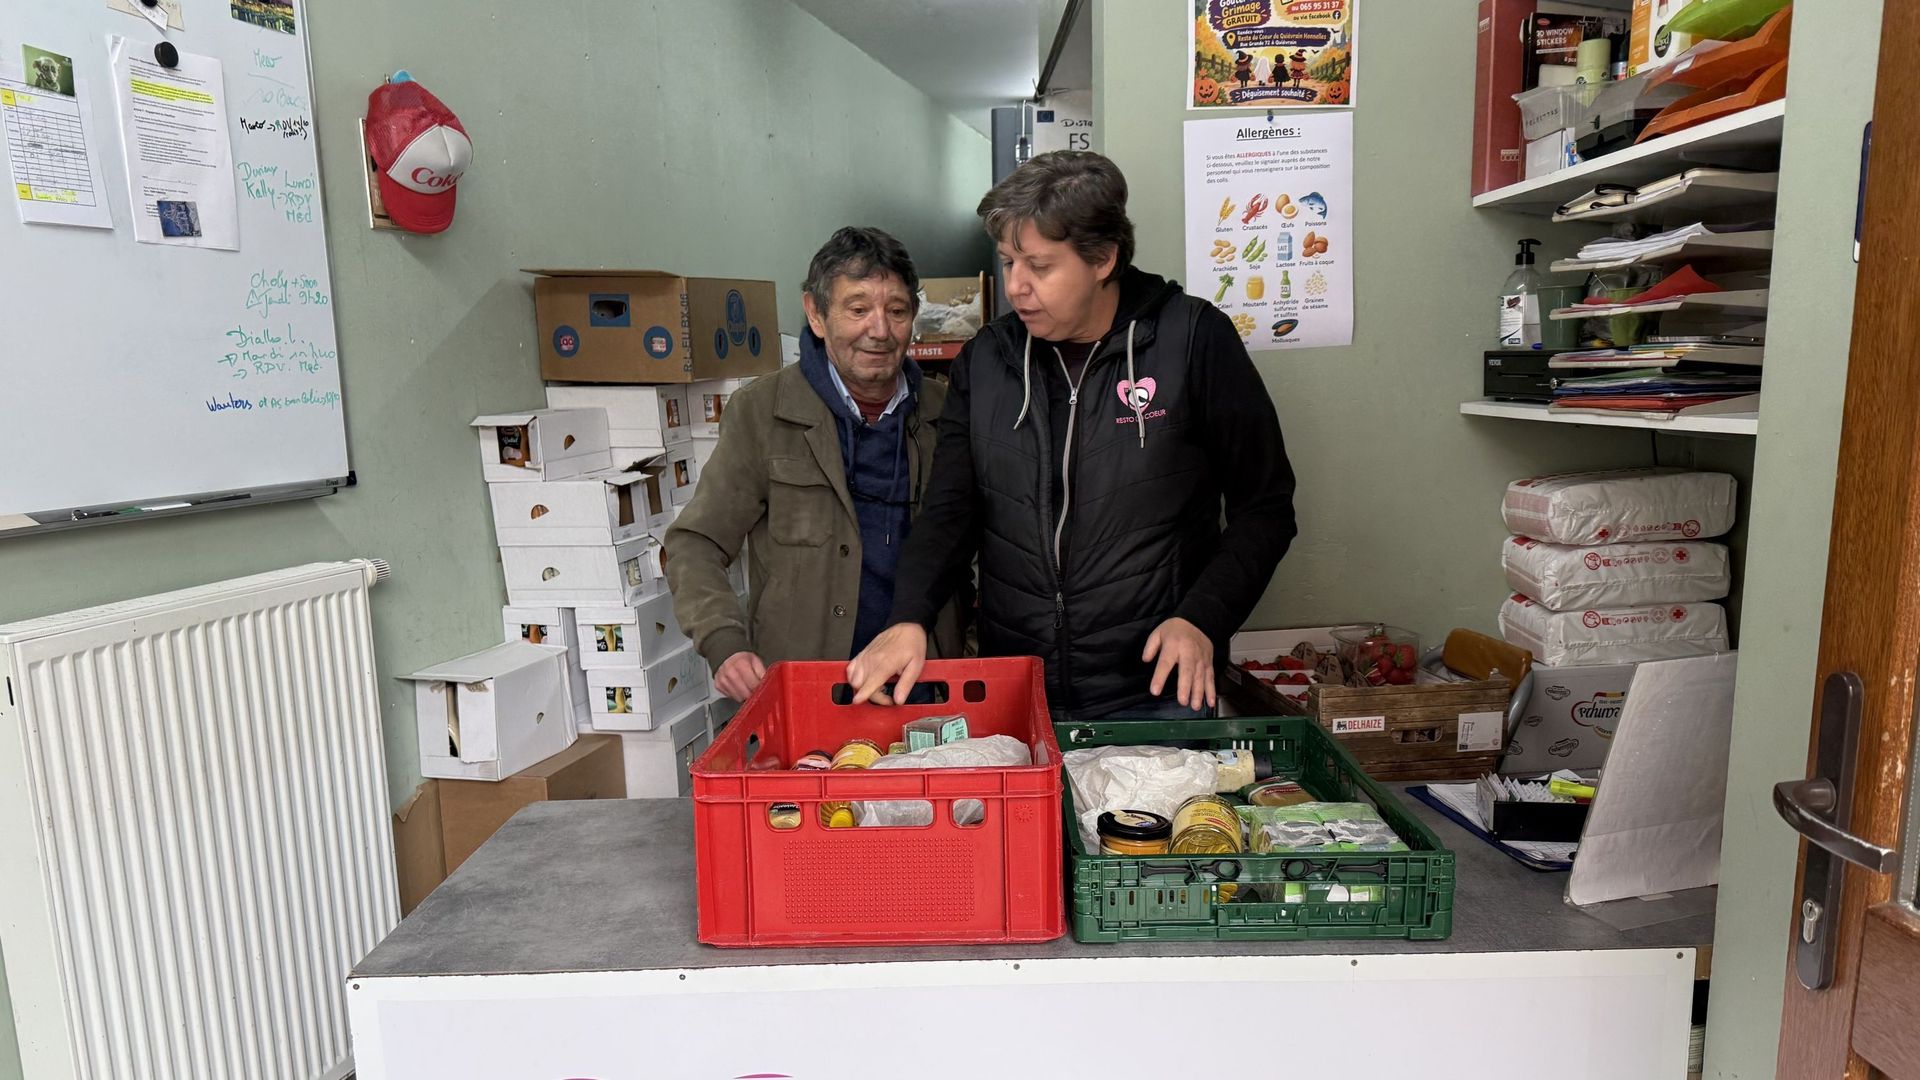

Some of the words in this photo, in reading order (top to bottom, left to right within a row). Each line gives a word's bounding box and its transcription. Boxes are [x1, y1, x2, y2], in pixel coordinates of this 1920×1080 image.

[1222, 1, 1261, 17] Grimage
[1226, 15, 1258, 26] GRATUIT
[1546, 27, 1574, 36] WINDOW
[1536, 36, 1567, 46] STICKERS
[1241, 88, 1280, 99] Déguisement
[1281, 89, 1305, 98] souhaité
[1236, 126, 1294, 140] Allergènes
[1271, 337, 1300, 345] Mollusques
[918, 347, 943, 356] TASTE
[1116, 416, 1134, 424] RESTO
[1145, 408, 1166, 420] COEUR
[1348, 719, 1381, 729] DELHAIZE
